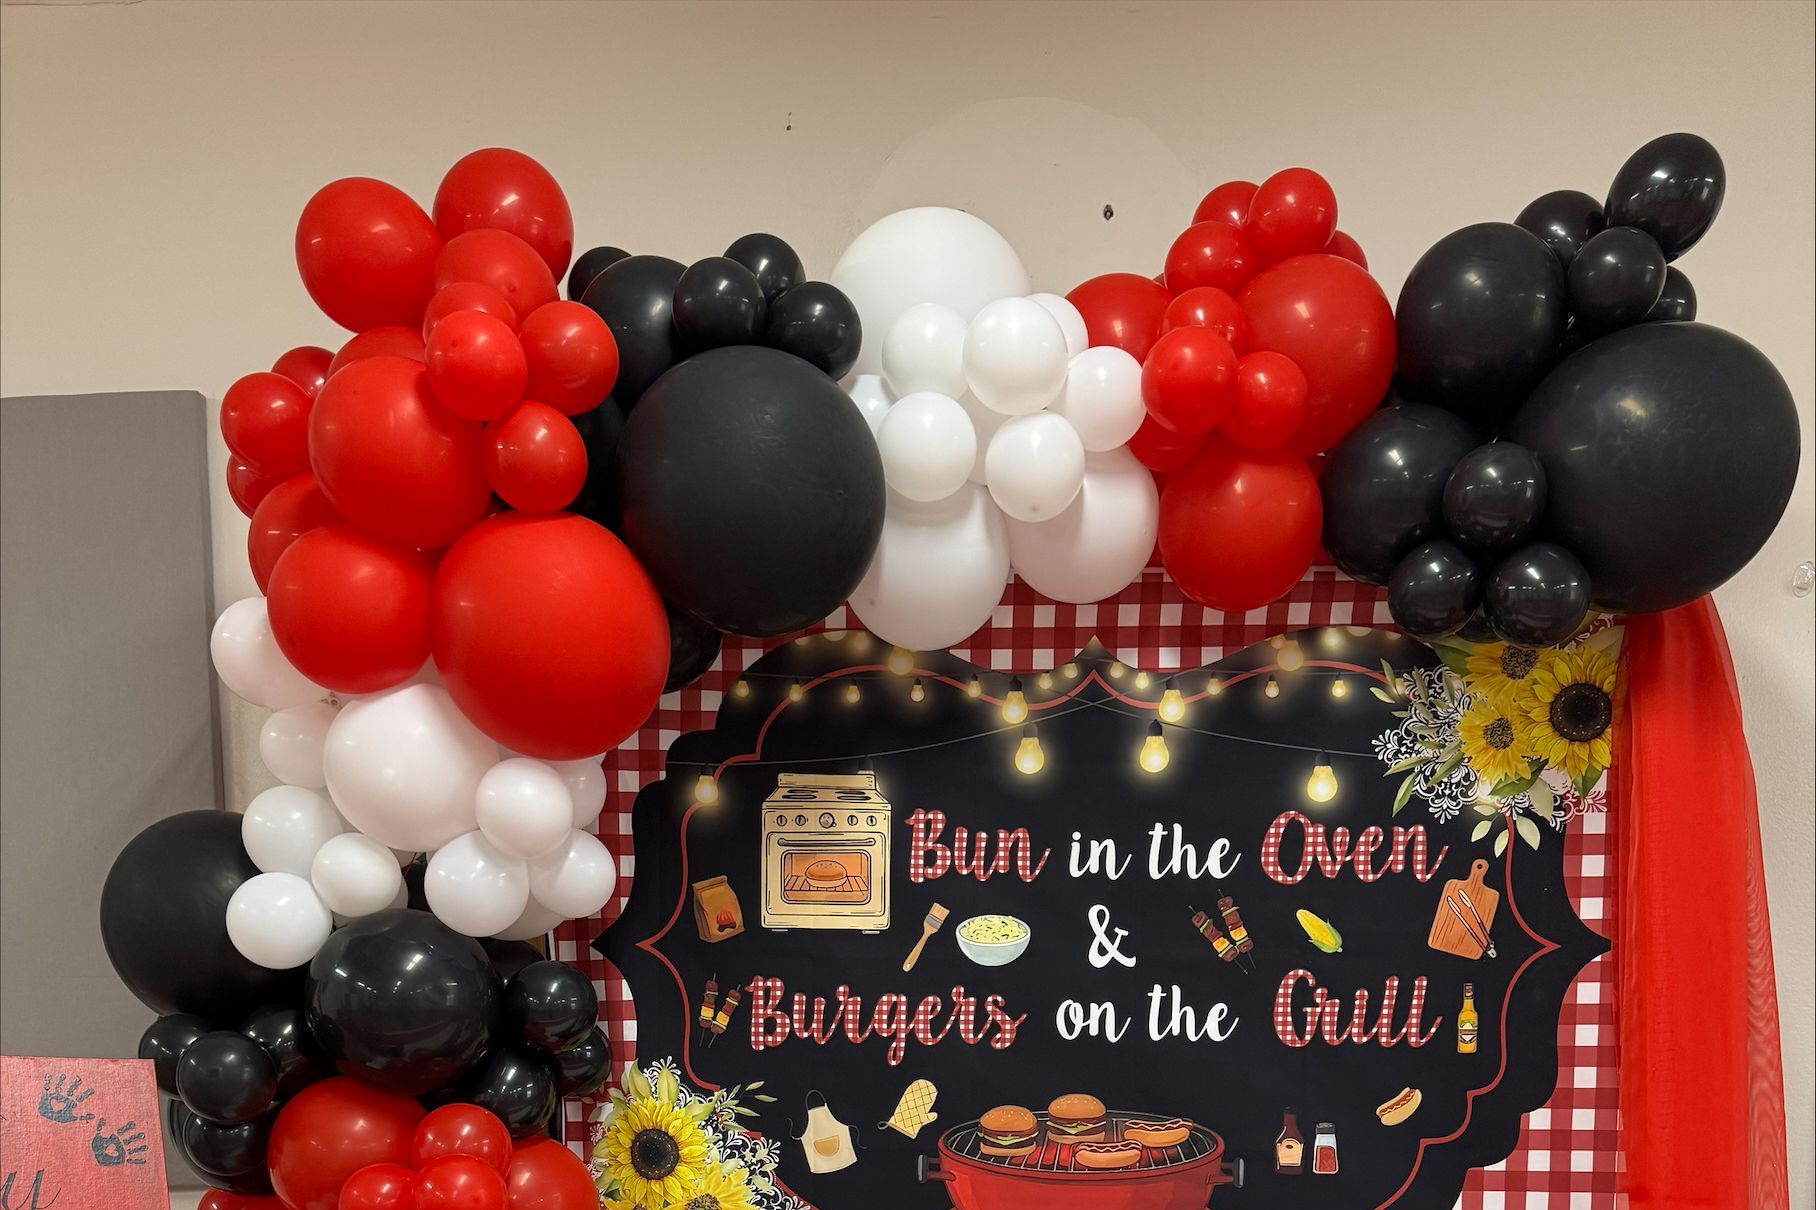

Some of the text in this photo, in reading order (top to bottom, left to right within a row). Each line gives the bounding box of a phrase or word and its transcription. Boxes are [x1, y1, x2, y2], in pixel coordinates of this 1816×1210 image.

[904, 808, 1449, 885] Bun in the Oven
[1088, 904, 1137, 968] &
[744, 969, 1443, 1066] Burgers on the Grill
